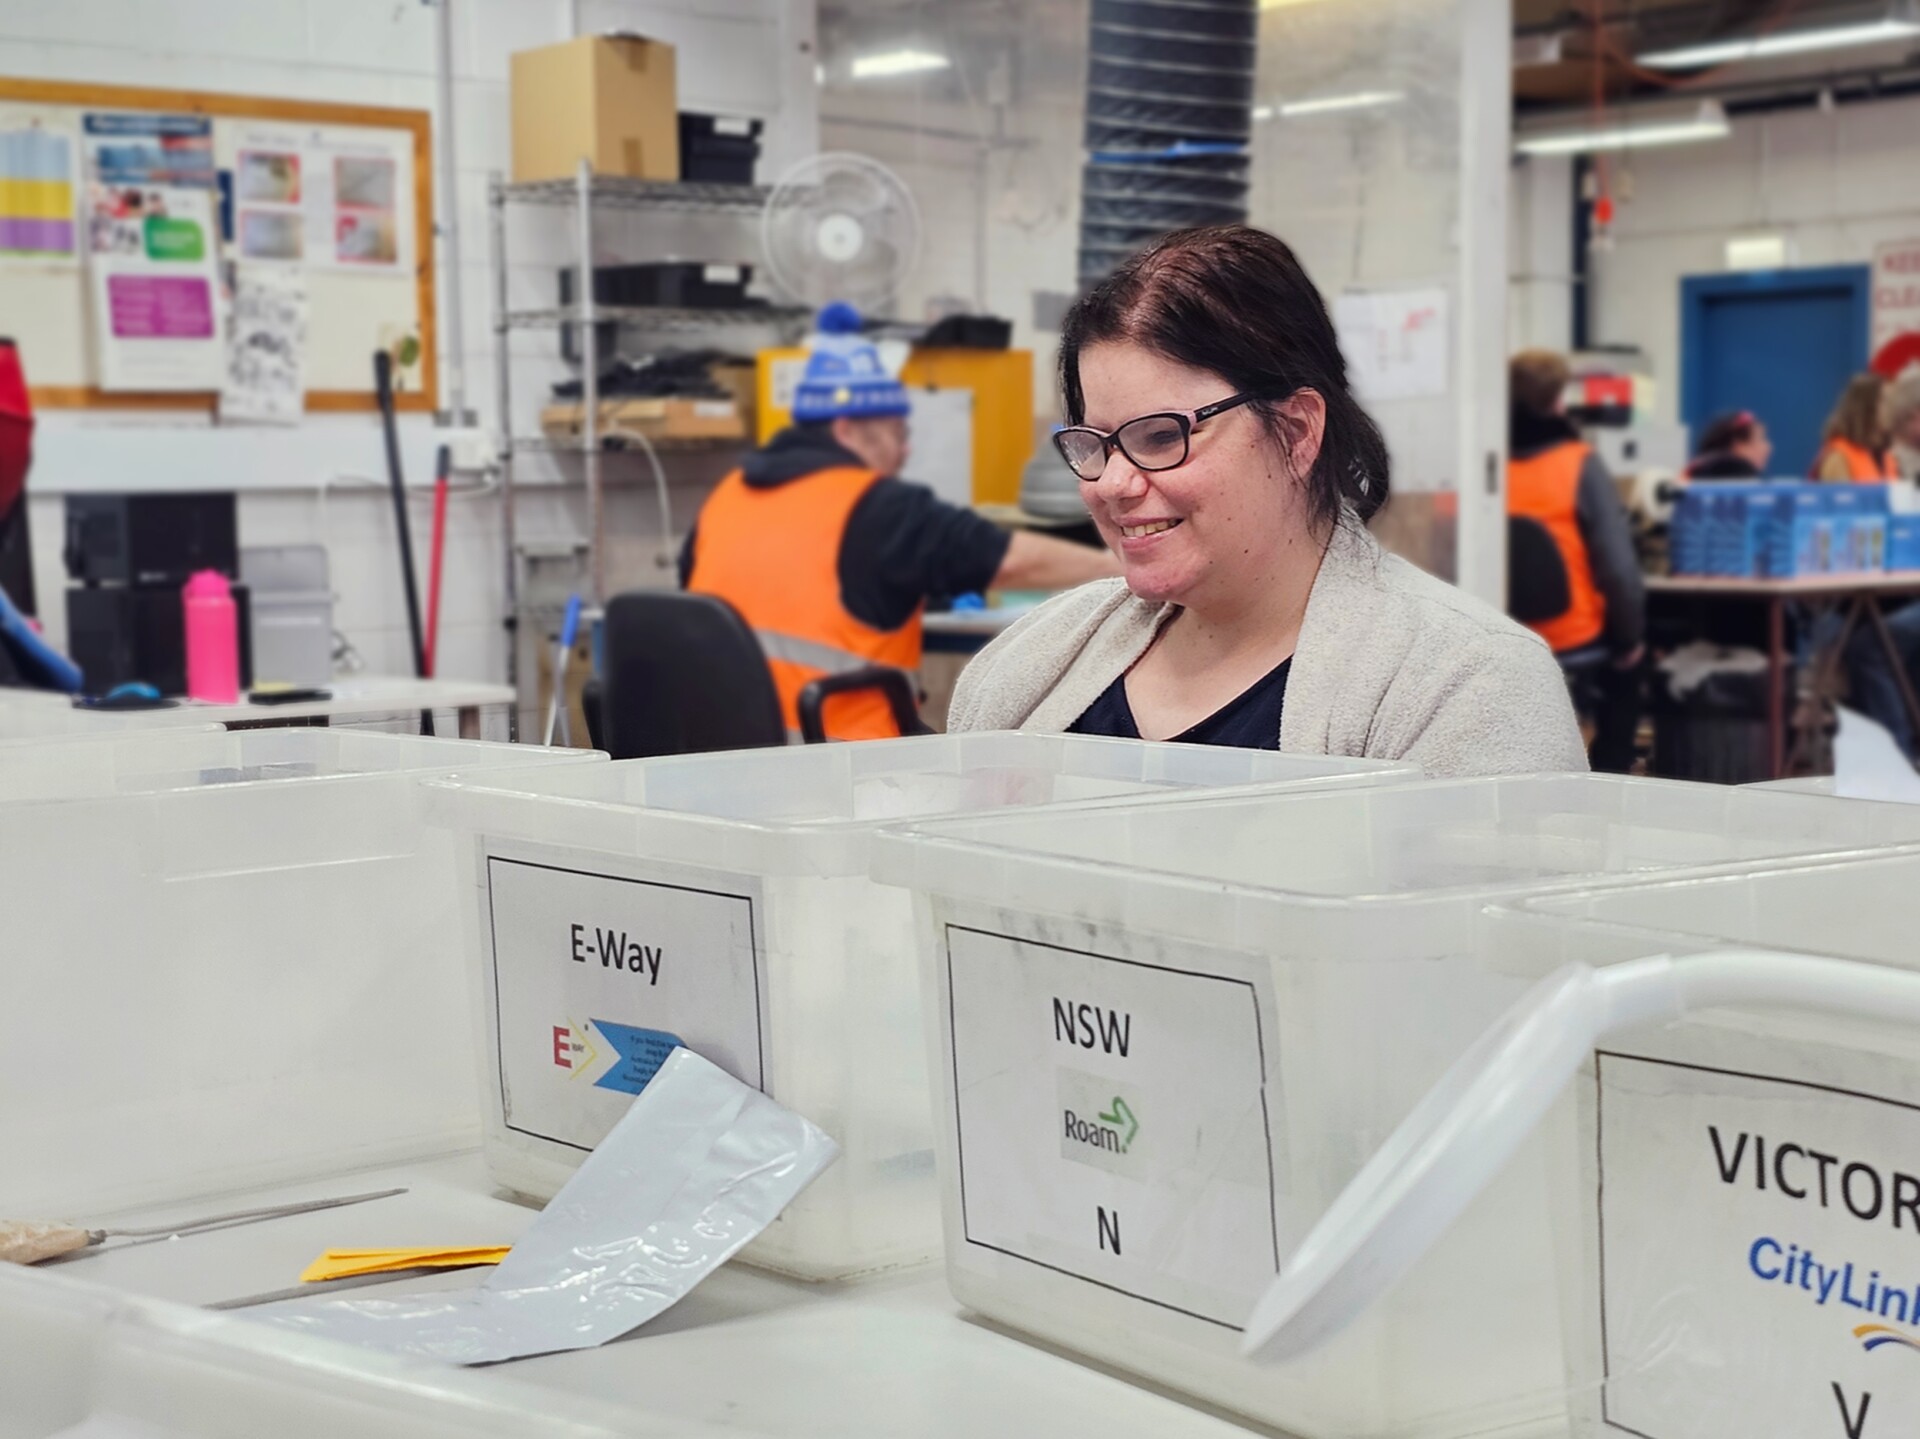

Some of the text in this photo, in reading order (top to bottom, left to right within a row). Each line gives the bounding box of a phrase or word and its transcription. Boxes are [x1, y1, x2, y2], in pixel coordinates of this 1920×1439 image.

[571, 923, 662, 986] E-Way
[553, 1025, 572, 1069] E
[1053, 997, 1130, 1058] NSW
[1097, 1206, 1121, 1256] N
[1831, 1381, 1871, 1439] V
